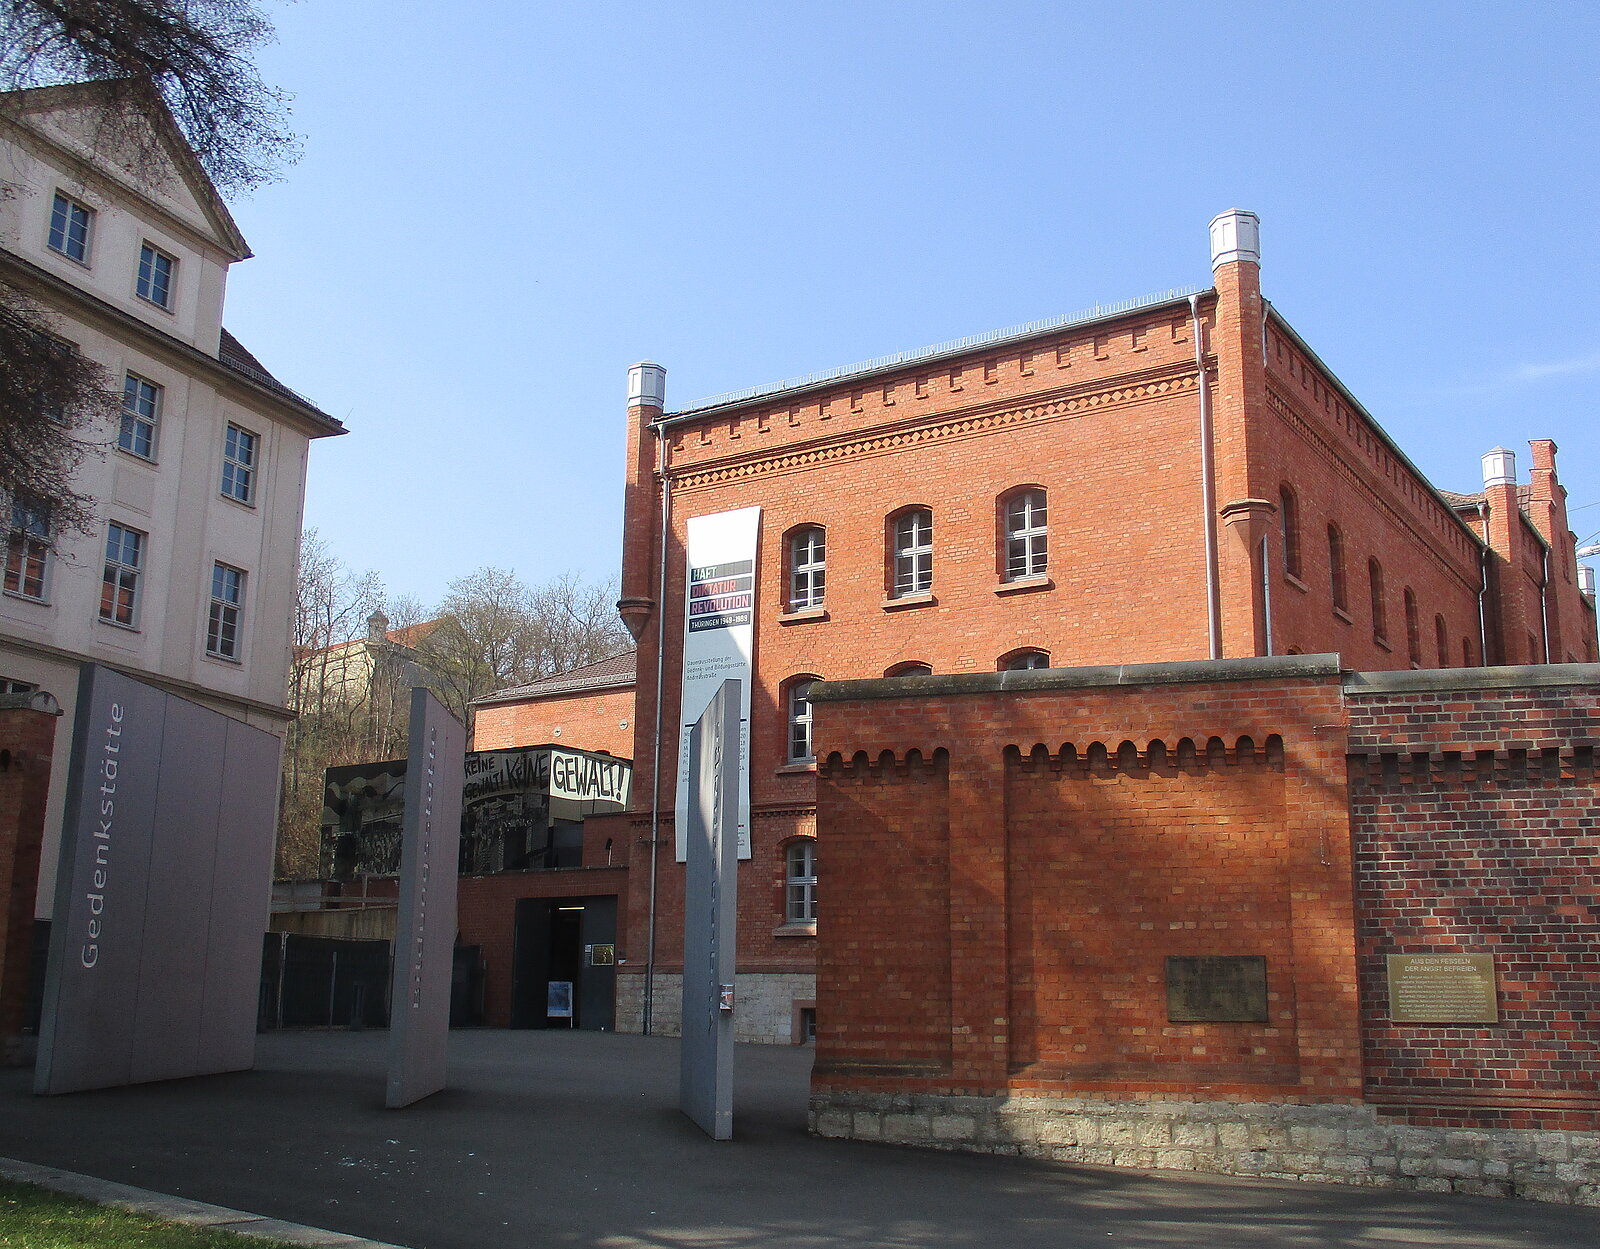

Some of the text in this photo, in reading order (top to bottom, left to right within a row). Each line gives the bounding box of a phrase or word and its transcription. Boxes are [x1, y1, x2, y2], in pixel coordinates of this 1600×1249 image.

[693, 567, 717, 581] HAFT
[692, 580, 737, 598] DIKTATUR
[691, 595, 749, 615] REVOLUTION
[553, 755, 625, 801] GEWALT!
[81, 702, 125, 968] Gedenkstätte
